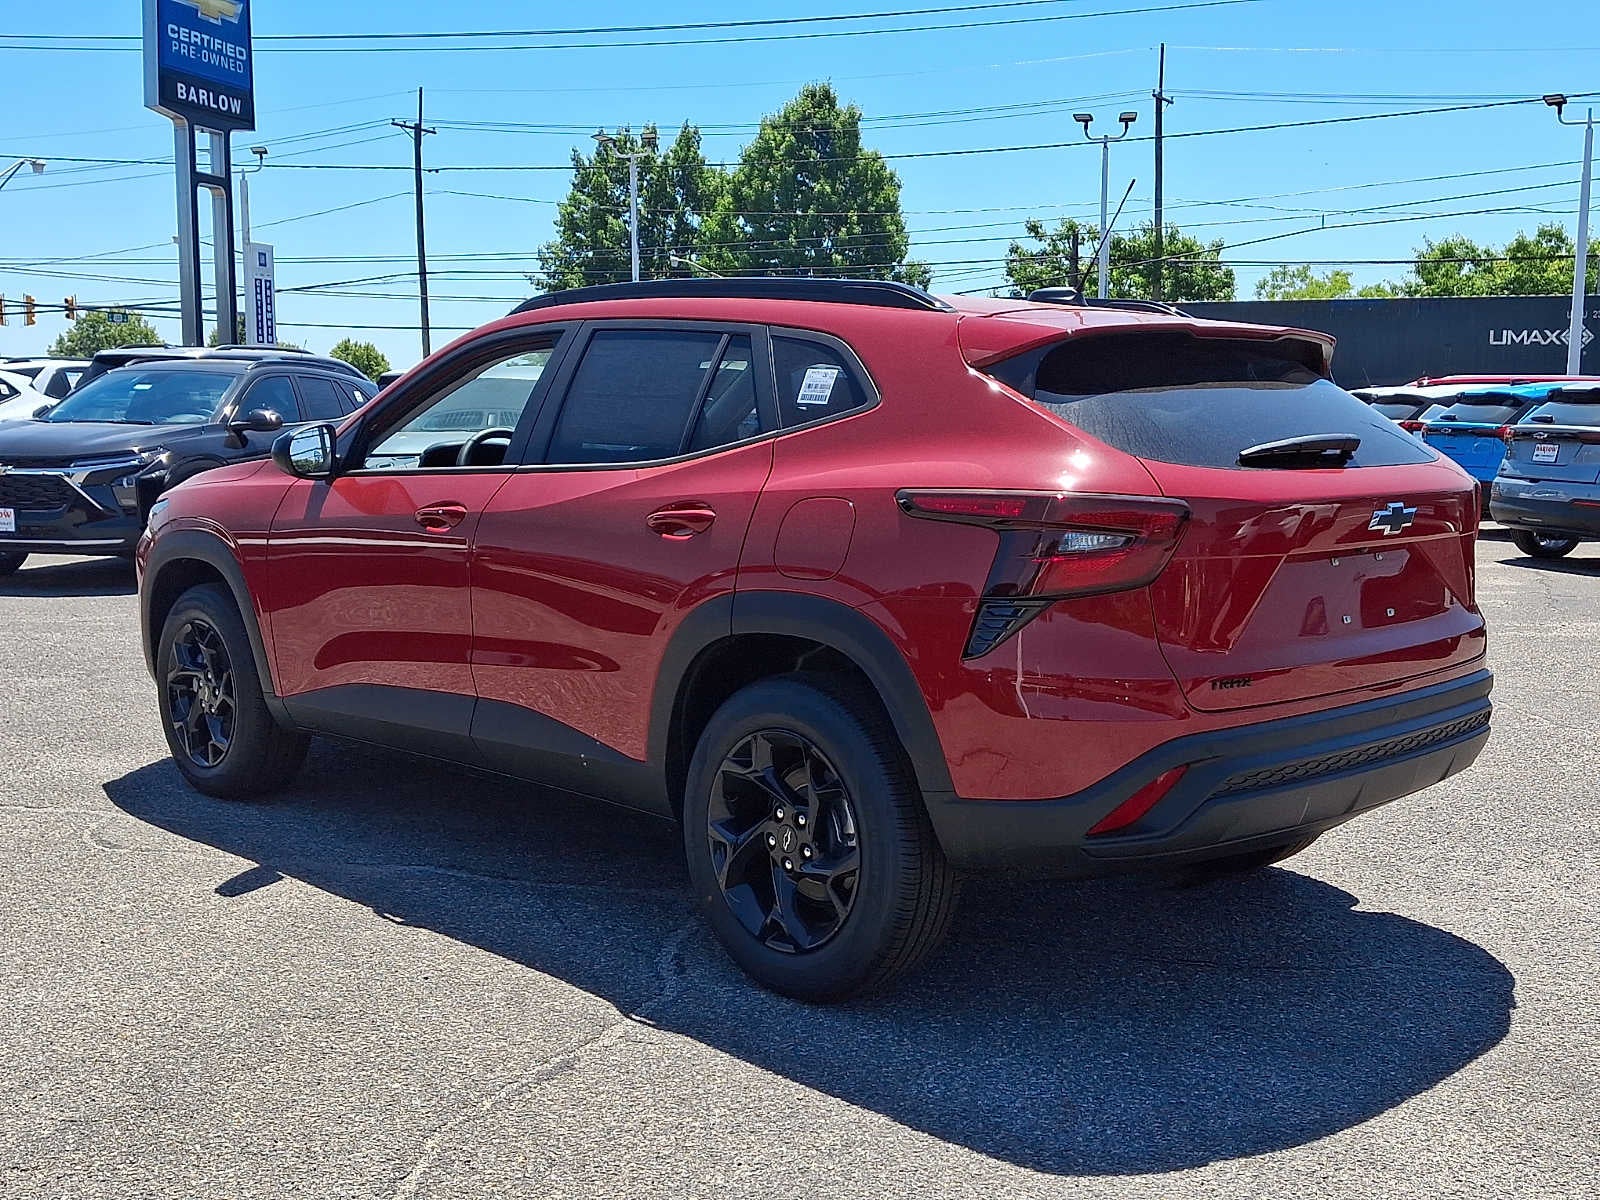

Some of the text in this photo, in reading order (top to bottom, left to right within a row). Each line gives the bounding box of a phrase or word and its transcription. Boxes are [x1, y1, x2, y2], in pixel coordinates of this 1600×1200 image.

[167, 23, 247, 61] CERTIFIED
[171, 40, 244, 73] PRE-OWNED
[176, 82, 241, 115] BARLOW
